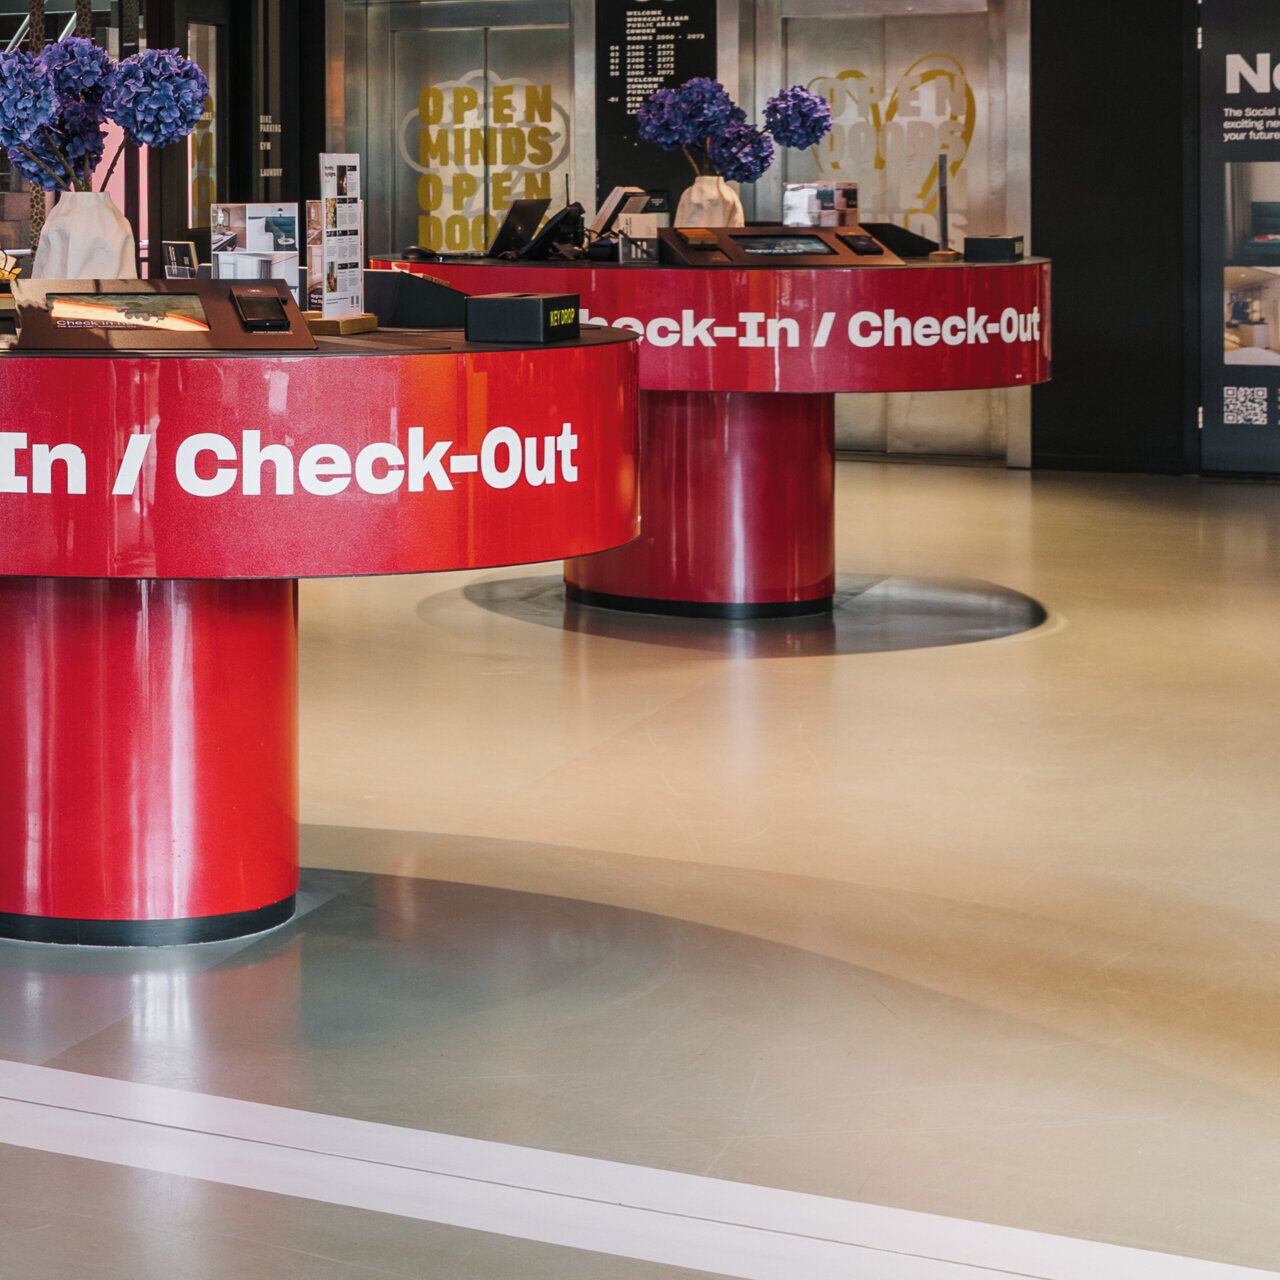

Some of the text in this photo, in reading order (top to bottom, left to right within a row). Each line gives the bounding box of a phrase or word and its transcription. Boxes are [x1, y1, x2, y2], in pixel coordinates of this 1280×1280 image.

[418, 84, 552, 125] OPEN
[819, 76, 966, 121] OPEN
[260, 115, 273, 124] BIKE
[1223, 106, 1276, 117] The Social
[260, 124, 282, 133] PARKING
[1223, 119, 1265, 130] exciting
[260, 142, 272, 150] GYM
[418, 126, 553, 166] MINDS
[819, 120, 966, 166] DOORS
[1223, 132, 1247, 143] your
[260, 168, 283, 177] LAUNDRY
[418, 172, 551, 211] OPEN
[550, 308, 575, 327] KEY DROP
[578, 306, 1041, 348] heck-In / Check-Out
[112, 434, 152, 495] /
[175, 422, 579, 498] Check-Out
